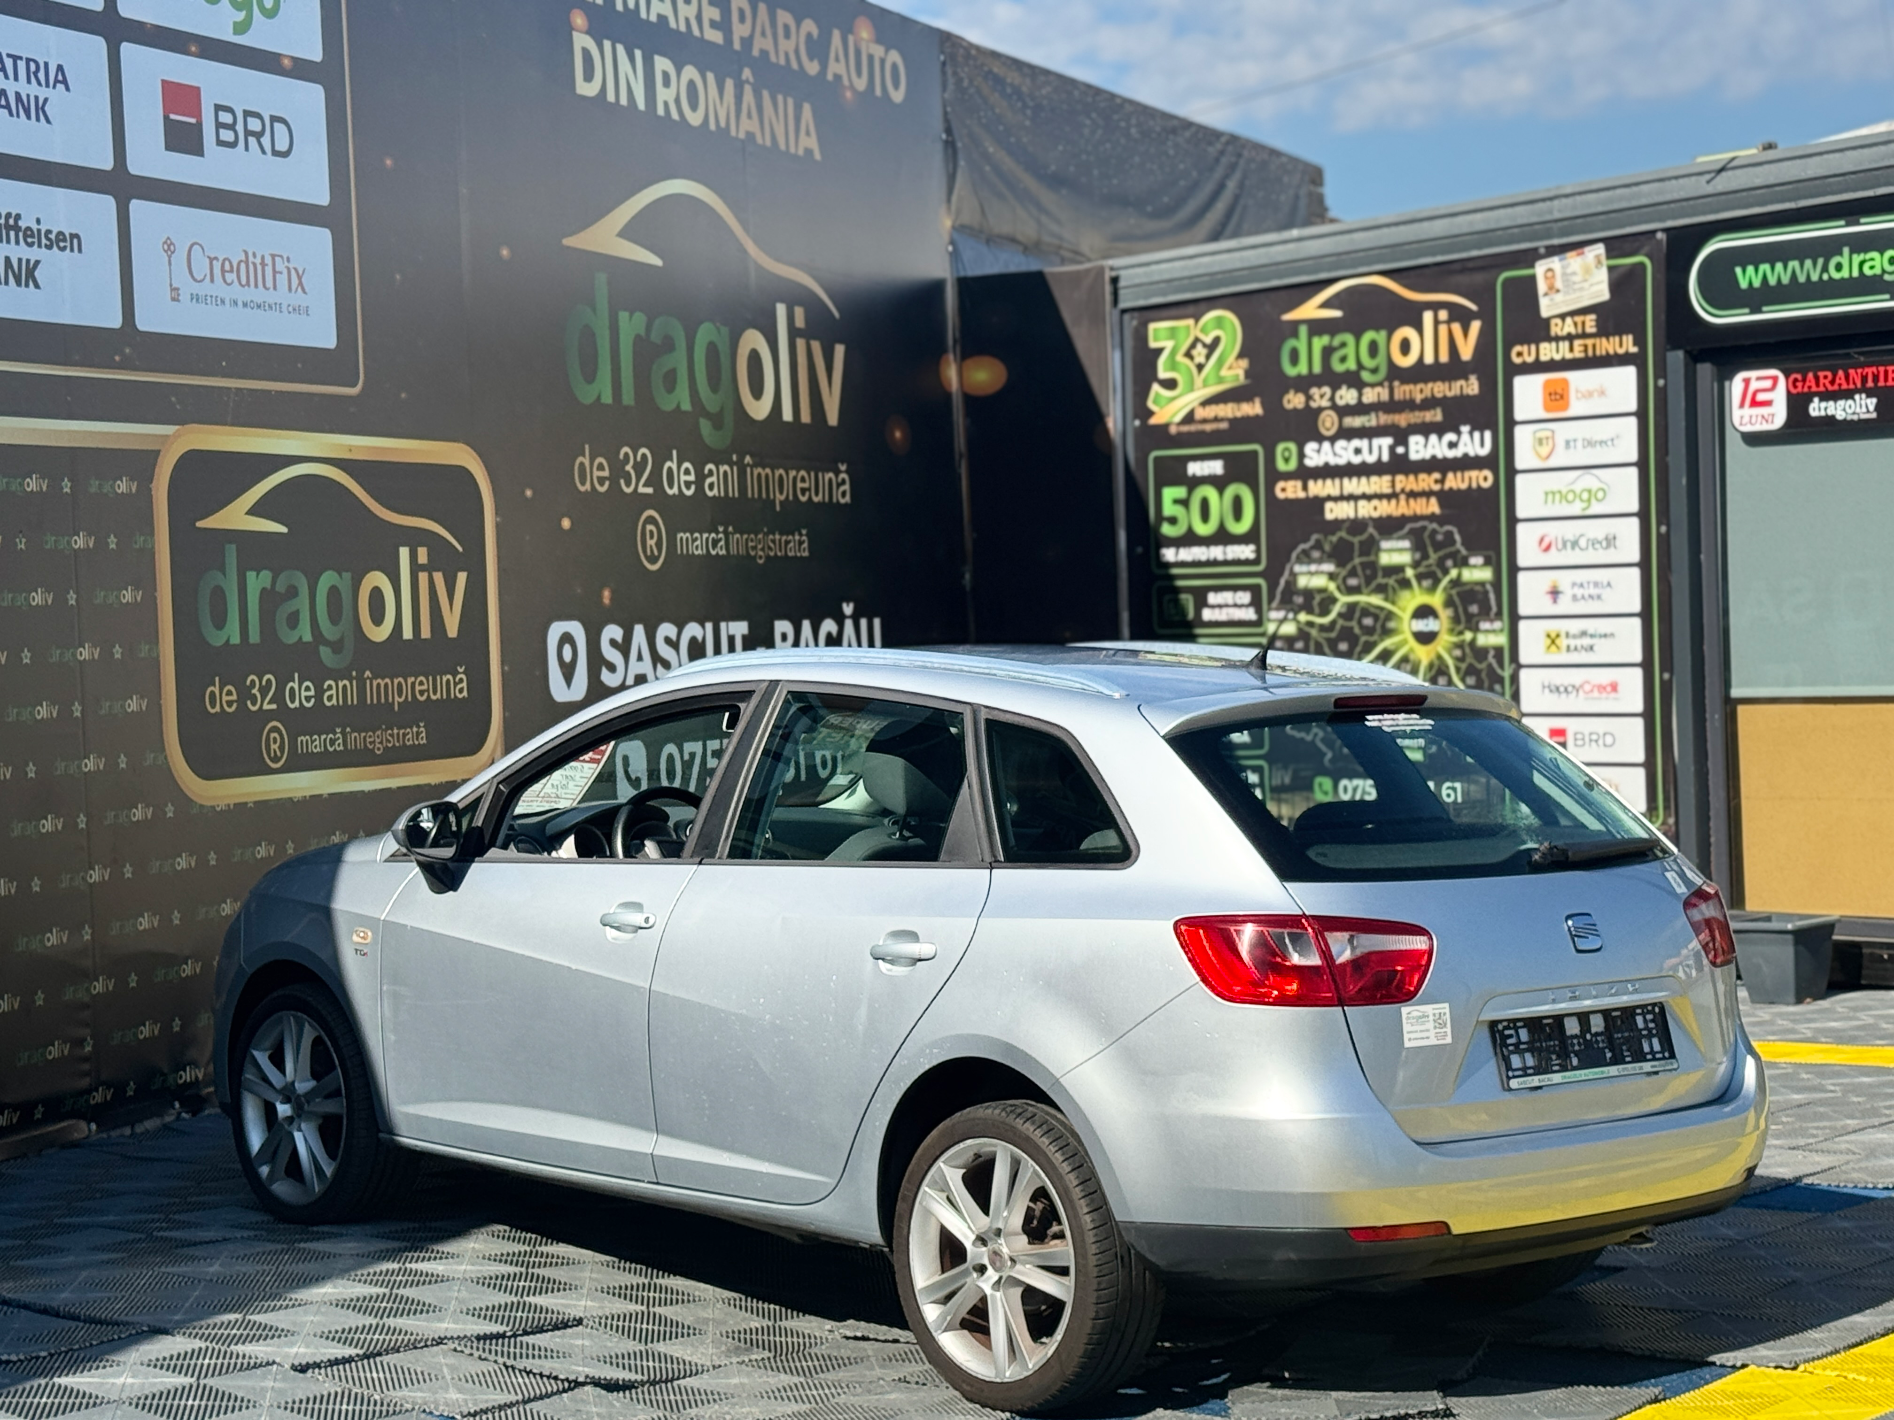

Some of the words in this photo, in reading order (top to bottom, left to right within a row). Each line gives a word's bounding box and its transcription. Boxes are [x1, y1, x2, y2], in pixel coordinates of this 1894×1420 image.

[731, 0, 820, 76] PARC
[826, 28, 907, 104] AUTO
[572, 30, 646, 111] DIN
[653, 54, 822, 161] ROMÂNIA
[213, 103, 294, 159] BRD
[186, 241, 308, 295] CreditFix
[190, 292, 226, 306] PRIETEN
[229, 297, 238, 308] IN
[241, 299, 283, 314] MOMENTE
[1550, 314, 1597, 337] RATE
[565, 272, 846, 450] dragoliv
[1146, 309, 1243, 414] 32
[1280, 309, 1482, 384] dragoliv
[1510, 345, 1536, 365] CU
[1538, 335, 1638, 362] BULETINUL
[1283, 389, 1306, 410] de
[1308, 385, 1332, 408] 32
[1335, 384, 1358, 406] de
[1361, 381, 1389, 404] ani
[1575, 384, 1607, 401] bank
[1738, 375, 1779, 409] 12
[1808, 393, 1878, 421] dragoliv
[1739, 413, 1776, 427] LUNI
[1303, 437, 1394, 467] SASCUT
[1408, 424, 1492, 461] BACĂU
[1564, 439, 1577, 450] BT
[1582, 437, 1615, 449] Direct
[574, 445, 610, 493] de
[620, 446, 654, 494] 32
[662, 449, 696, 497] de
[704, 454, 738, 498] ani
[744, 455, 850, 511] împreună
[1274, 479, 1307, 499] CEL
[1307, 477, 1341, 498] MAI
[1342, 474, 1394, 497] MARE
[1394, 471, 1442, 494] PARC
[1443, 468, 1494, 491] AUTO
[1160, 482, 1255, 539] 500
[1324, 500, 1356, 520] DIN
[1356, 494, 1441, 519] ROMÂNIA
[1543, 483, 1607, 512] mogo
[676, 526, 726, 556] marcă
[729, 526, 810, 564] înregistrată
[1554, 532, 1618, 553] UniCredit
[1571, 580, 1613, 591] PATRIA
[1571, 593, 1604, 603] BANK
[198, 543, 468, 669] dragoliv
[205, 677, 237, 714] de
[246, 675, 277, 711] 32
[285, 672, 315, 710] de
[323, 670, 357, 707] ani
[364, 666, 468, 713] împreună
[1541, 679, 1619, 697] HappyCredit
[297, 726, 344, 755] marcă
[346, 722, 427, 754] înregistrată
[1572, 731, 1616, 749] BRD
